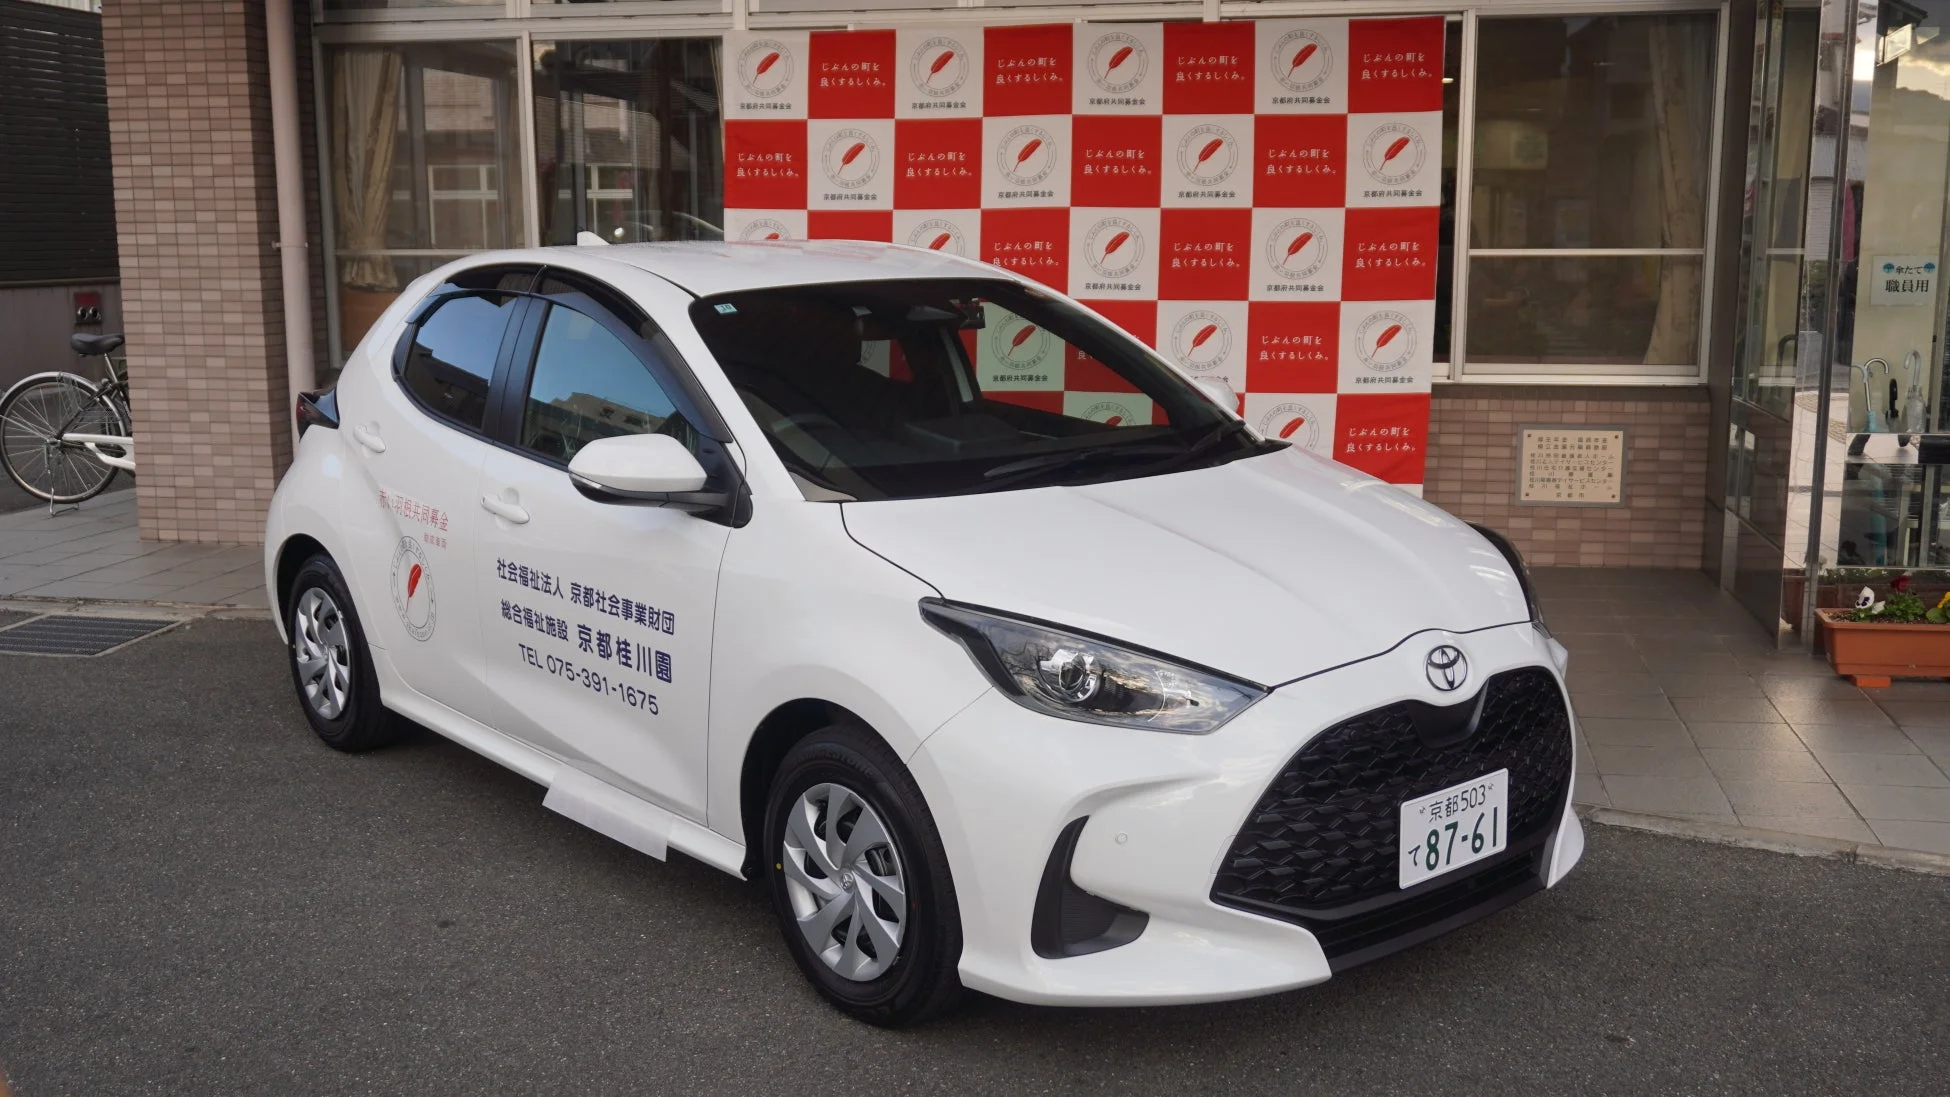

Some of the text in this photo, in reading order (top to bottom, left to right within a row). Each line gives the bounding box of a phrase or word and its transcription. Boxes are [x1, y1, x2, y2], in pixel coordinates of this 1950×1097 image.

[1178, 56, 1237, 65] じぶんの町を
[1364, 53, 1424, 62] じぶんの町を
[823, 62, 879, 71] じぶんの町を
[998, 58, 1056, 68] じぶんの町を
[1176, 71, 1244, 81] 良くするしくみ。
[1361, 68, 1432, 79] 良くするしくみ。
[820, 78, 885, 87] 良くするしくみ。
[996, 73, 1062, 84] 良くするしくみ。
[739, 153, 791, 162] じぶんの町を
[909, 152, 965, 161] じぶんの町を
[1087, 150, 1144, 159] じぶんの町を
[1269, 149, 1329, 158] じぶんの町を
[737, 168, 798, 176] 良くするしくみ。
[906, 167, 971, 177] 良くするしくみ。
[1084, 165, 1151, 174] 良くするしくみ。
[1267, 165, 1336, 174] 良くするしくみ。
[995, 241, 1052, 251] じぶんの町を
[1174, 242, 1233, 252] じぶんの町を
[1359, 242, 1419, 251] じぶんの町を
[992, 257, 1058, 266] 良くするしくみ。
[1172, 258, 1239, 267] 良くするしくみ。
[1356, 258, 1425, 268] 良くするしくみ。
[1885, 279, 1929, 293] 職員用
[1262, 336, 1321, 345] じぶんの町を
[1260, 351, 1328, 360] 良くするしくみ。
[1350, 427, 1409, 436] じぶんの町を
[1346, 443, 1415, 452] 良くするしくみ。
[496, 557, 675, 636] 社会福祉法人 京都社会事業財団
[501, 598, 672, 683] 総合福祉施設 京都桂川園
[518, 643, 659, 716] TEL 075-391-1675
[1426, 806, 1498, 871] 87-61
